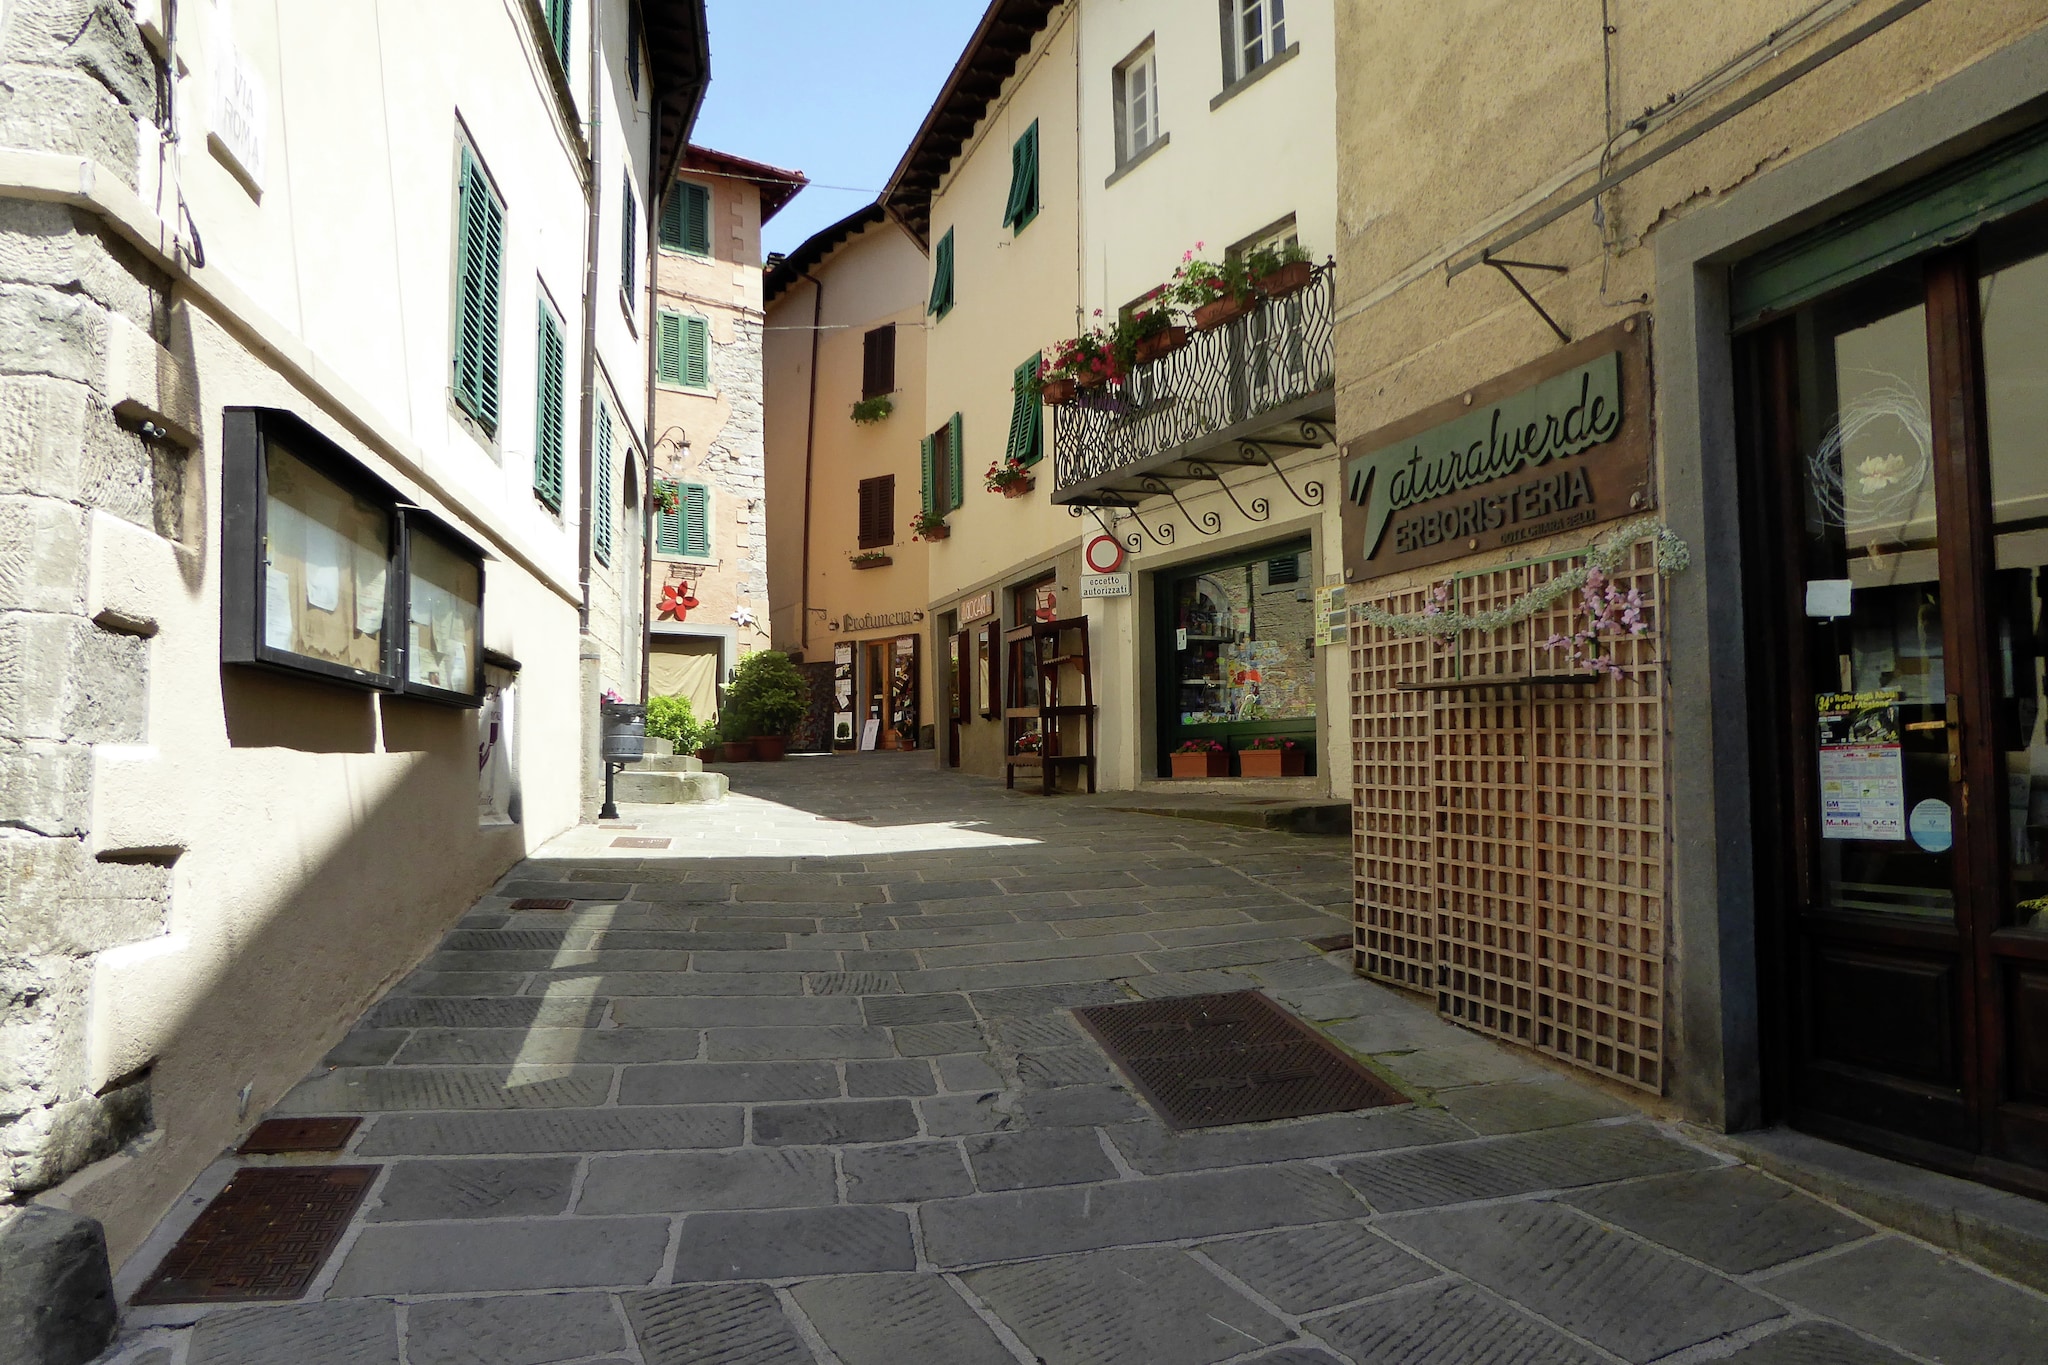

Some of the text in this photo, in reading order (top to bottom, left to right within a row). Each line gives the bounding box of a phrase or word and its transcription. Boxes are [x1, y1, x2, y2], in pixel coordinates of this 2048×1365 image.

[234, 66, 254, 118] VIA
[223, 96, 259, 168] ROMA
[1396, 467, 1592, 553] ERBORISTERIA
[1083, 585, 1127, 596] autorizzati
[1090, 576, 1120, 586] eccetto
[843, 610, 913, 633] Profumeria
